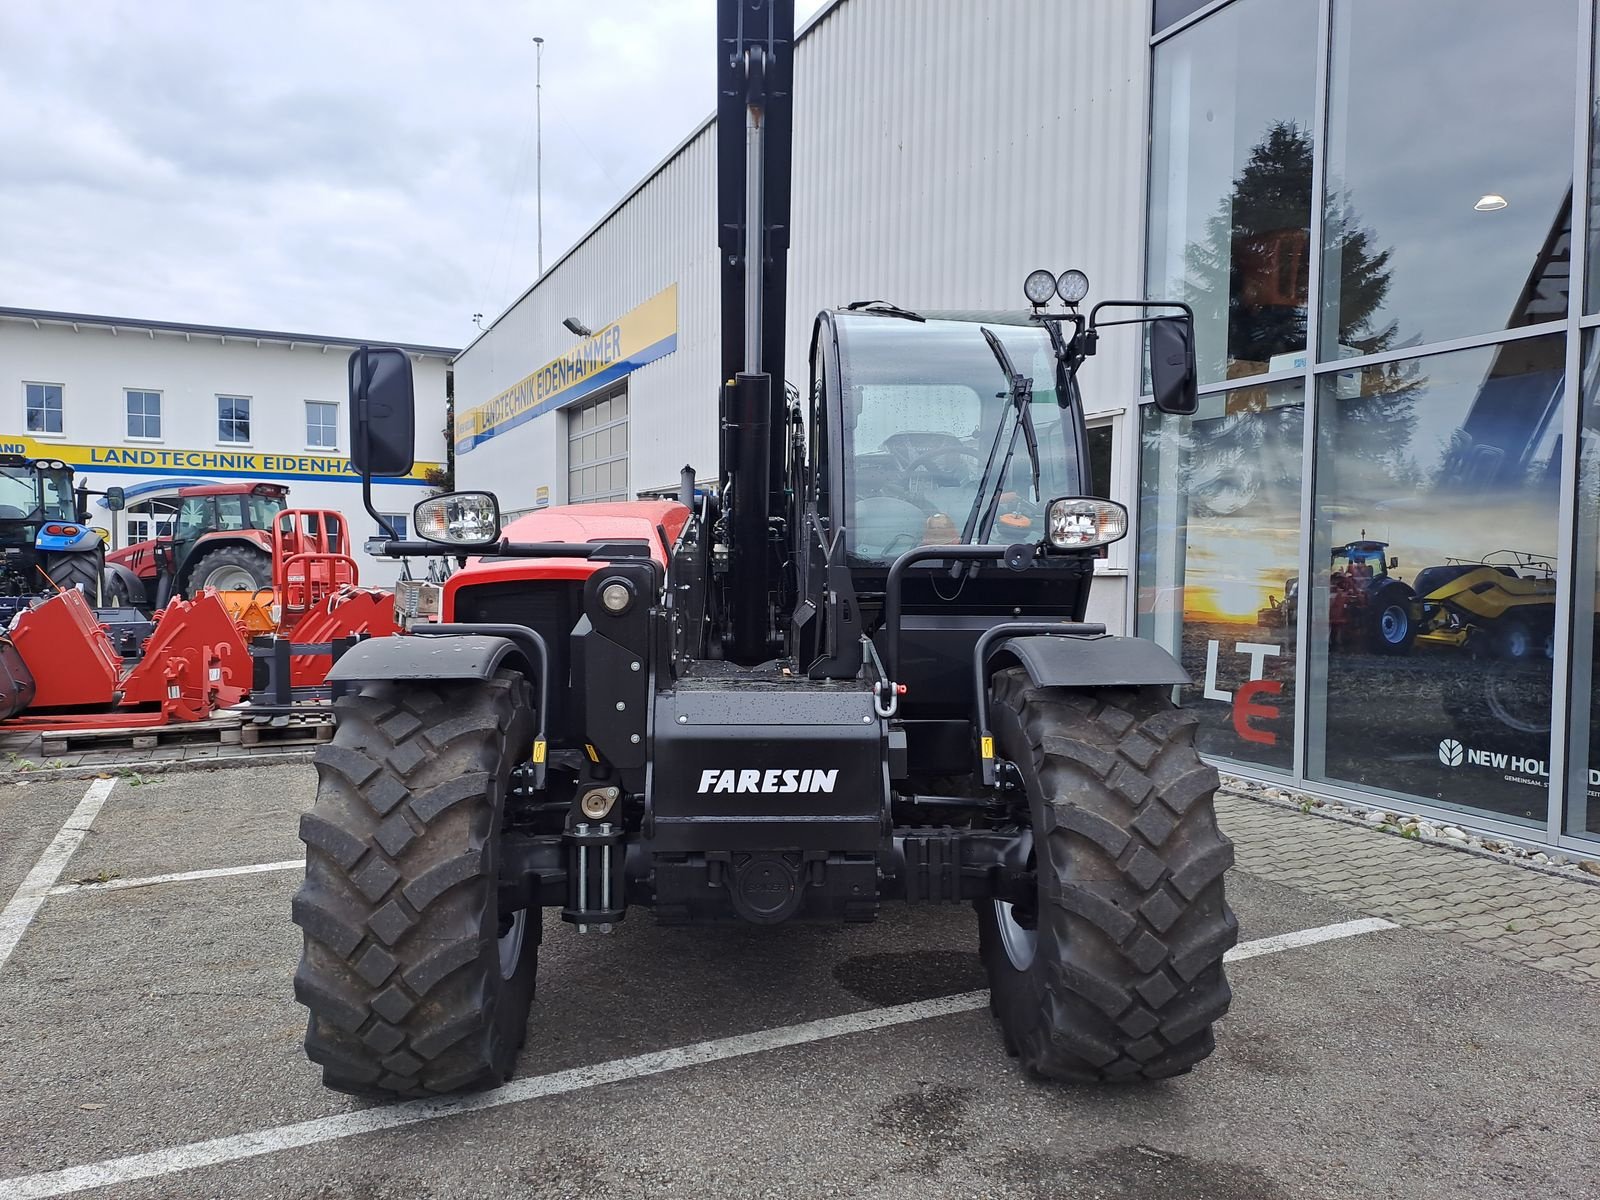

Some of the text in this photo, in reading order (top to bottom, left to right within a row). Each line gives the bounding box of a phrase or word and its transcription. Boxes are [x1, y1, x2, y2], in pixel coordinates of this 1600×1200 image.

[482, 325, 621, 429] LANDTECHNIK EIDENHAMMER
[91, 448, 257, 469] LANDTECHNIK
[1468, 748, 1508, 769] NEW
[697, 769, 839, 793] FARESIN
